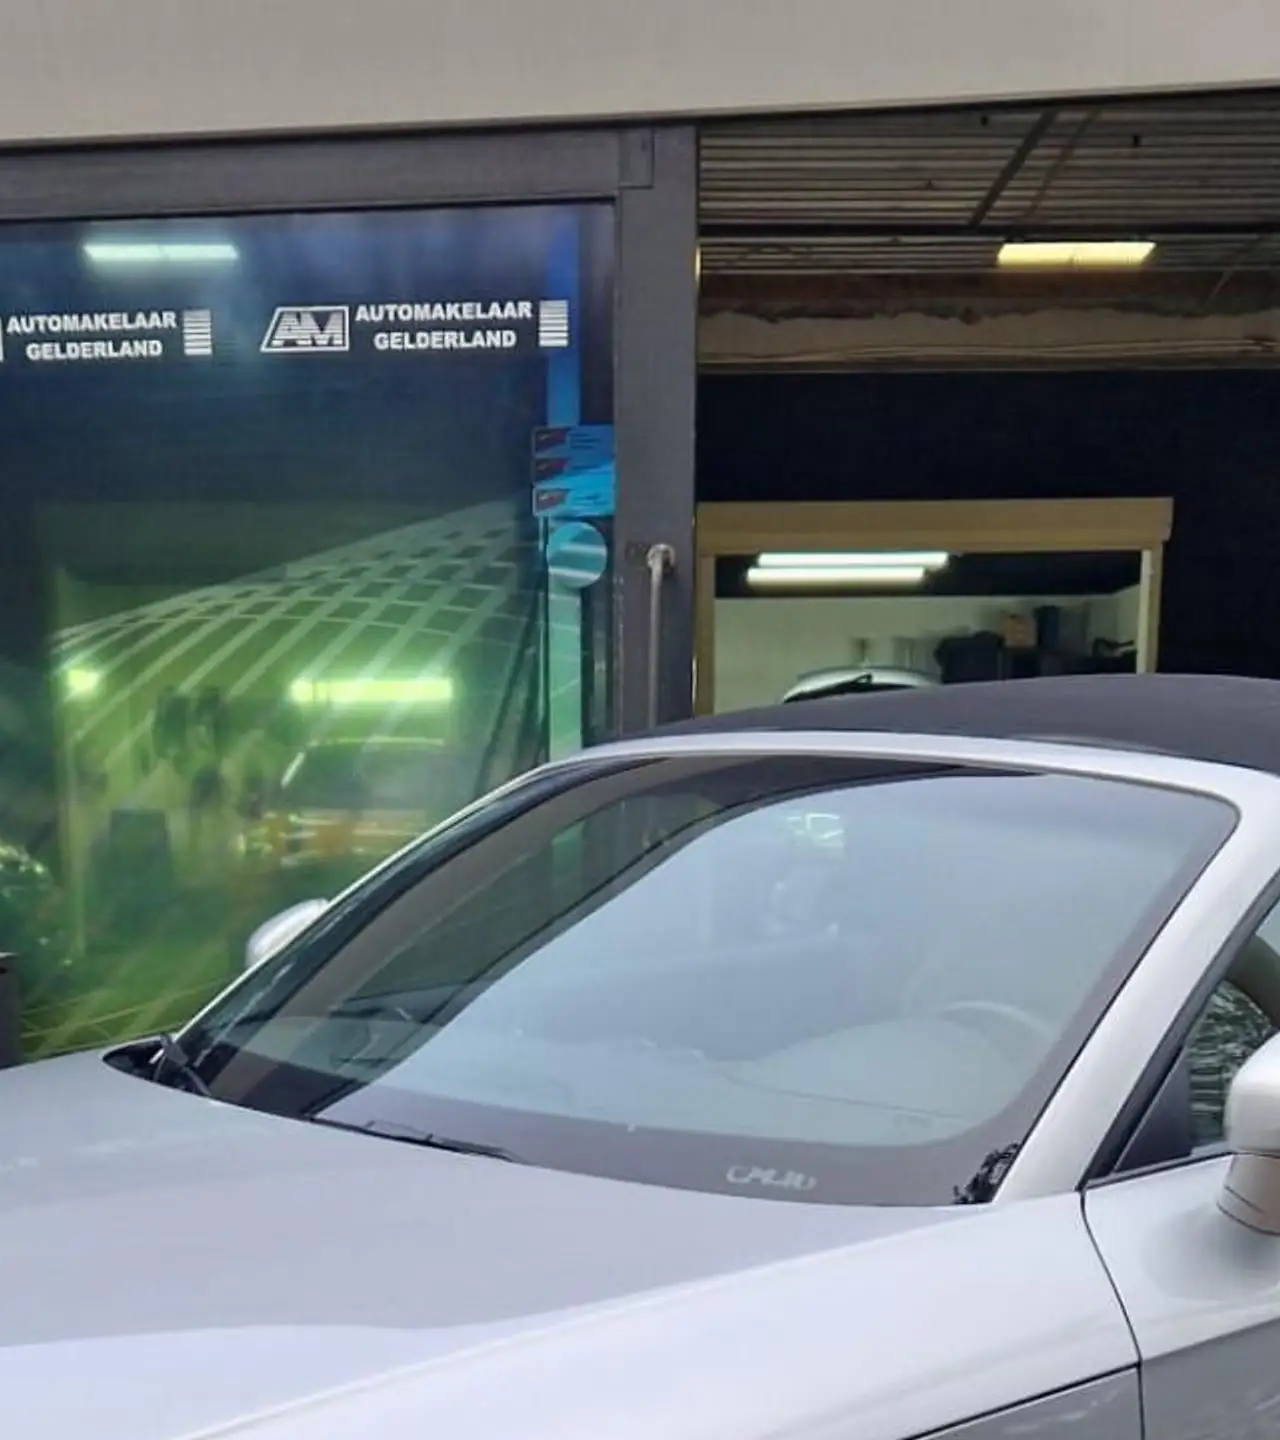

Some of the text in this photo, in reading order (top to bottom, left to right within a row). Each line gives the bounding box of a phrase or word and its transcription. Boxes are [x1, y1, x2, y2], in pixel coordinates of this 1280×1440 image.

[6, 310, 176, 334] AUTOMAKELAAR
[355, 301, 533, 322] AUTOMAKELAAR
[270, 310, 344, 347] AM
[26, 339, 163, 361] GELDERLAND
[374, 330, 517, 350] GELDERLAND
